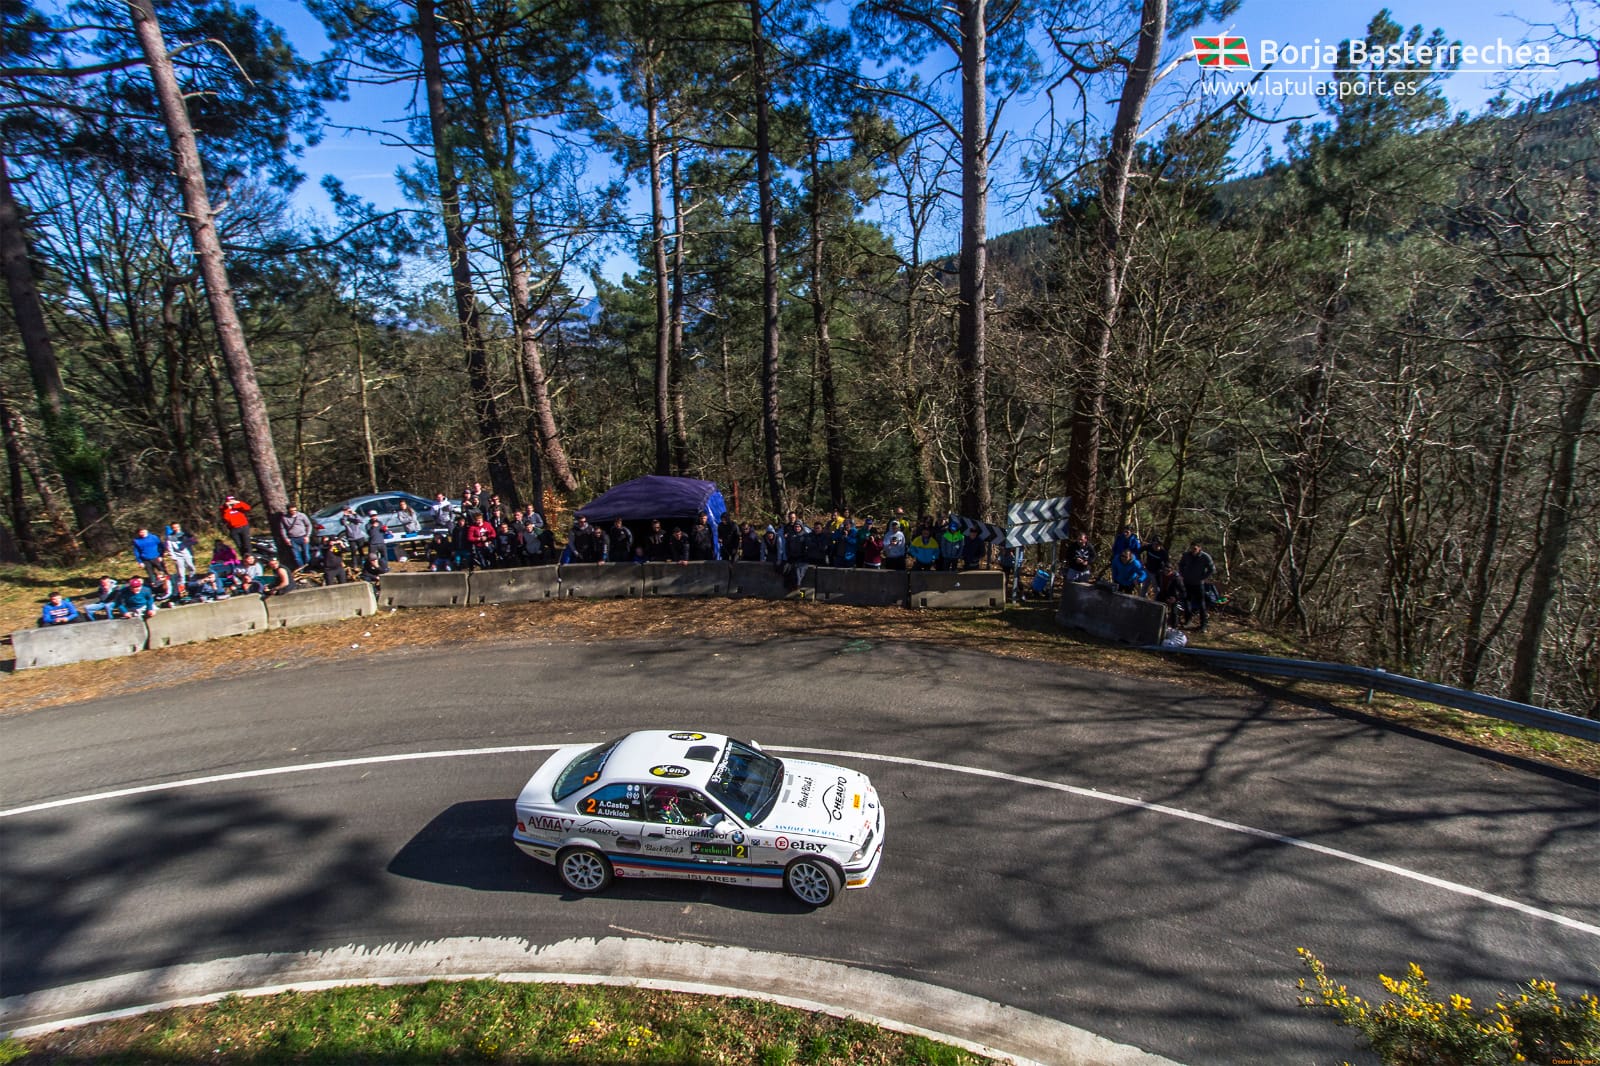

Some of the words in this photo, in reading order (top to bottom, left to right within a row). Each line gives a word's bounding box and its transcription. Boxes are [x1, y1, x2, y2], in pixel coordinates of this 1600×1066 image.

[599, 800, 629, 810] A.Castro
[832, 776, 847, 821] CHEAUTO
[586, 798, 596, 813] 2
[598, 809, 630, 817] A.Urkiola
[528, 816, 562, 832] AYMA
[579, 827, 619, 836] CHEAUTO
[736, 845, 745, 858] 2
[790, 840, 828, 853] elay
